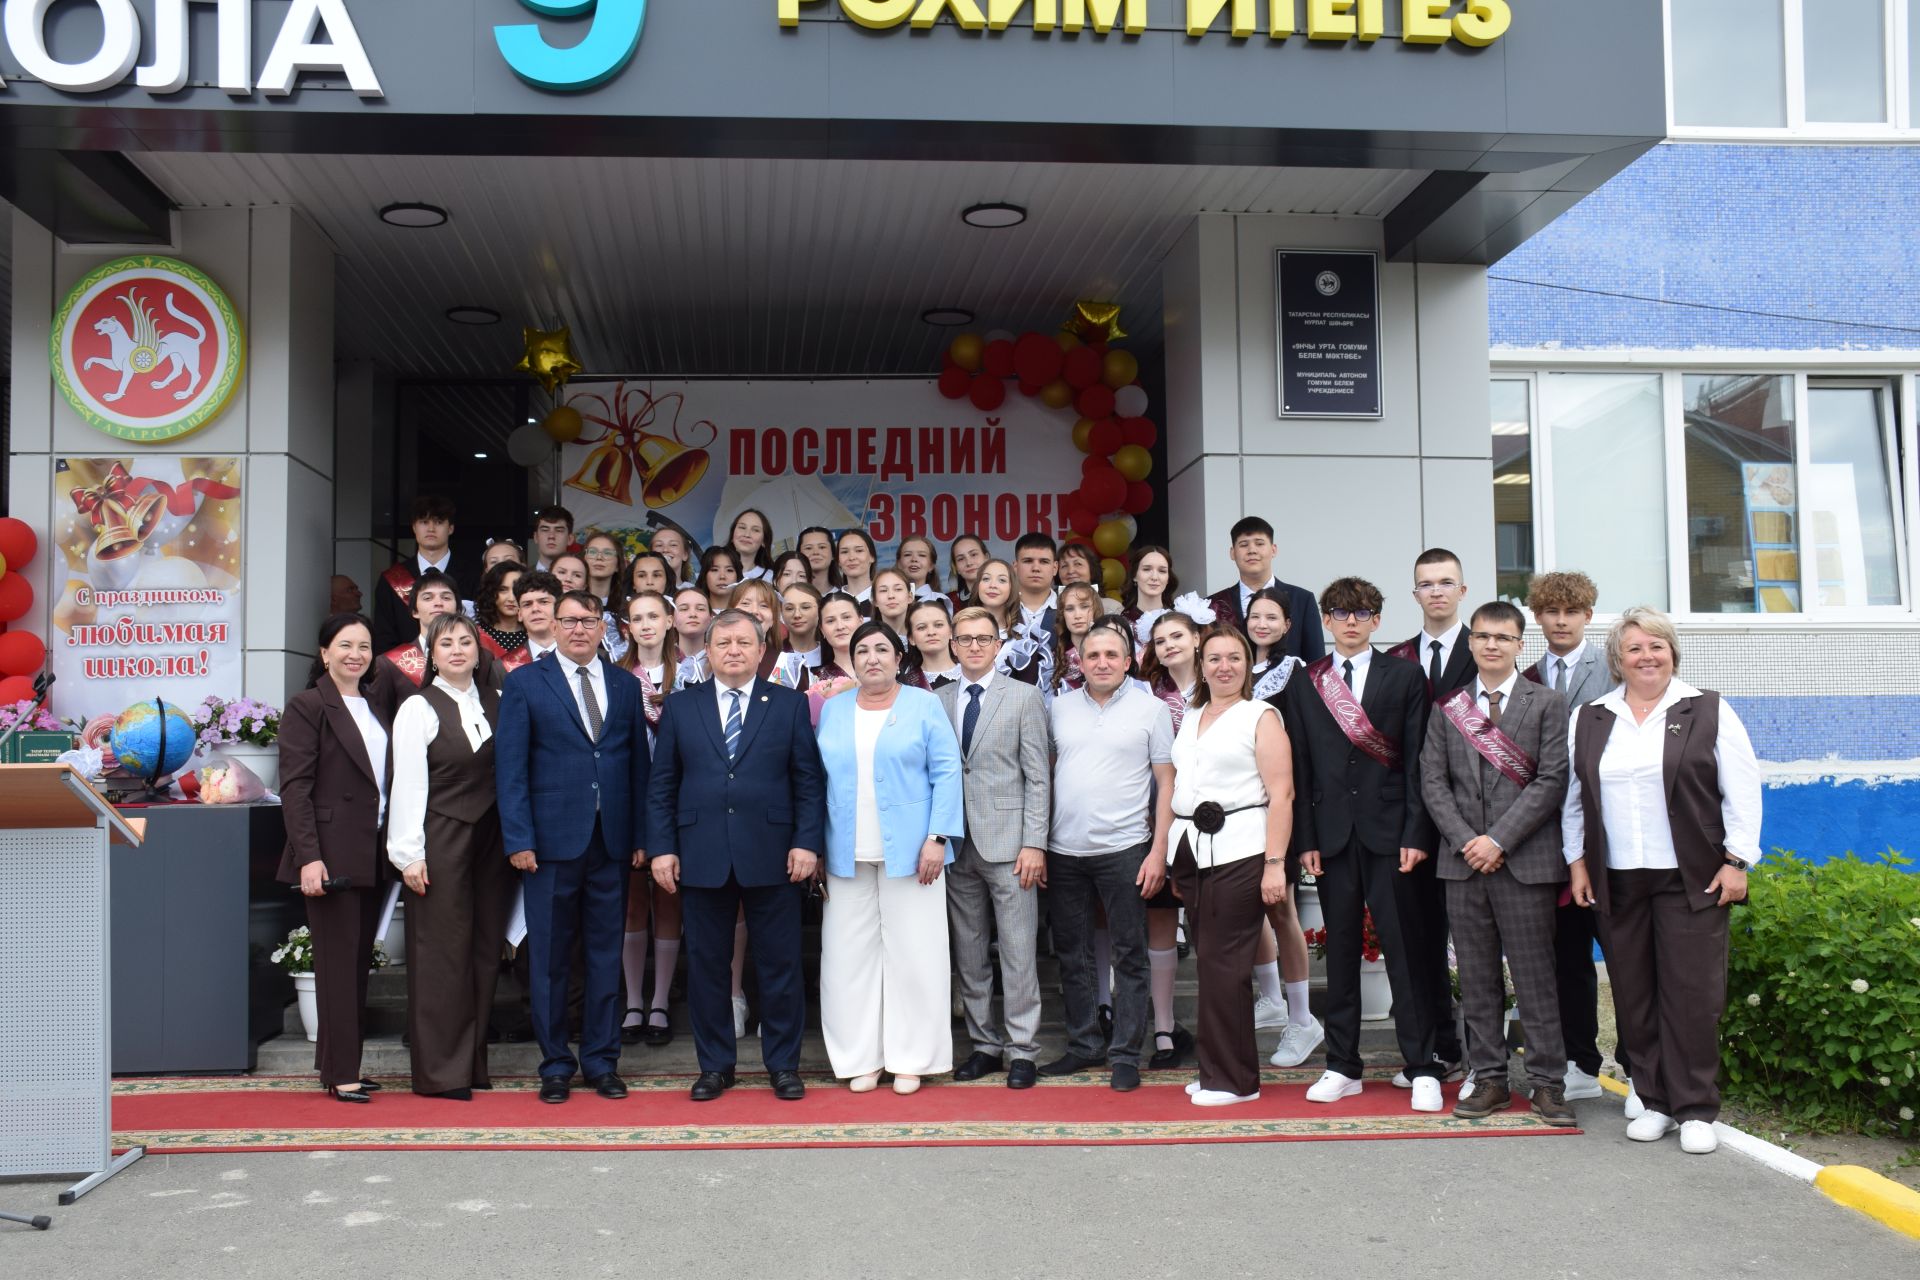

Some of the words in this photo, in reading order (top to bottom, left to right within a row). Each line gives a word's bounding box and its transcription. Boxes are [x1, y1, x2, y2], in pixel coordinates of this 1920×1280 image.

[0, 0, 385, 97] ОЛА
[92, 416, 198, 440] ТАТАРСТАН
[729, 417, 1007, 482] ПОСЛЕДНИЙ
[869, 493, 1071, 542] ЗВОНОК!
[76, 588, 90, 606] С
[94, 588, 224, 608] праздником,
[67, 616, 228, 646] любимая
[84, 649, 209, 679] школа!
